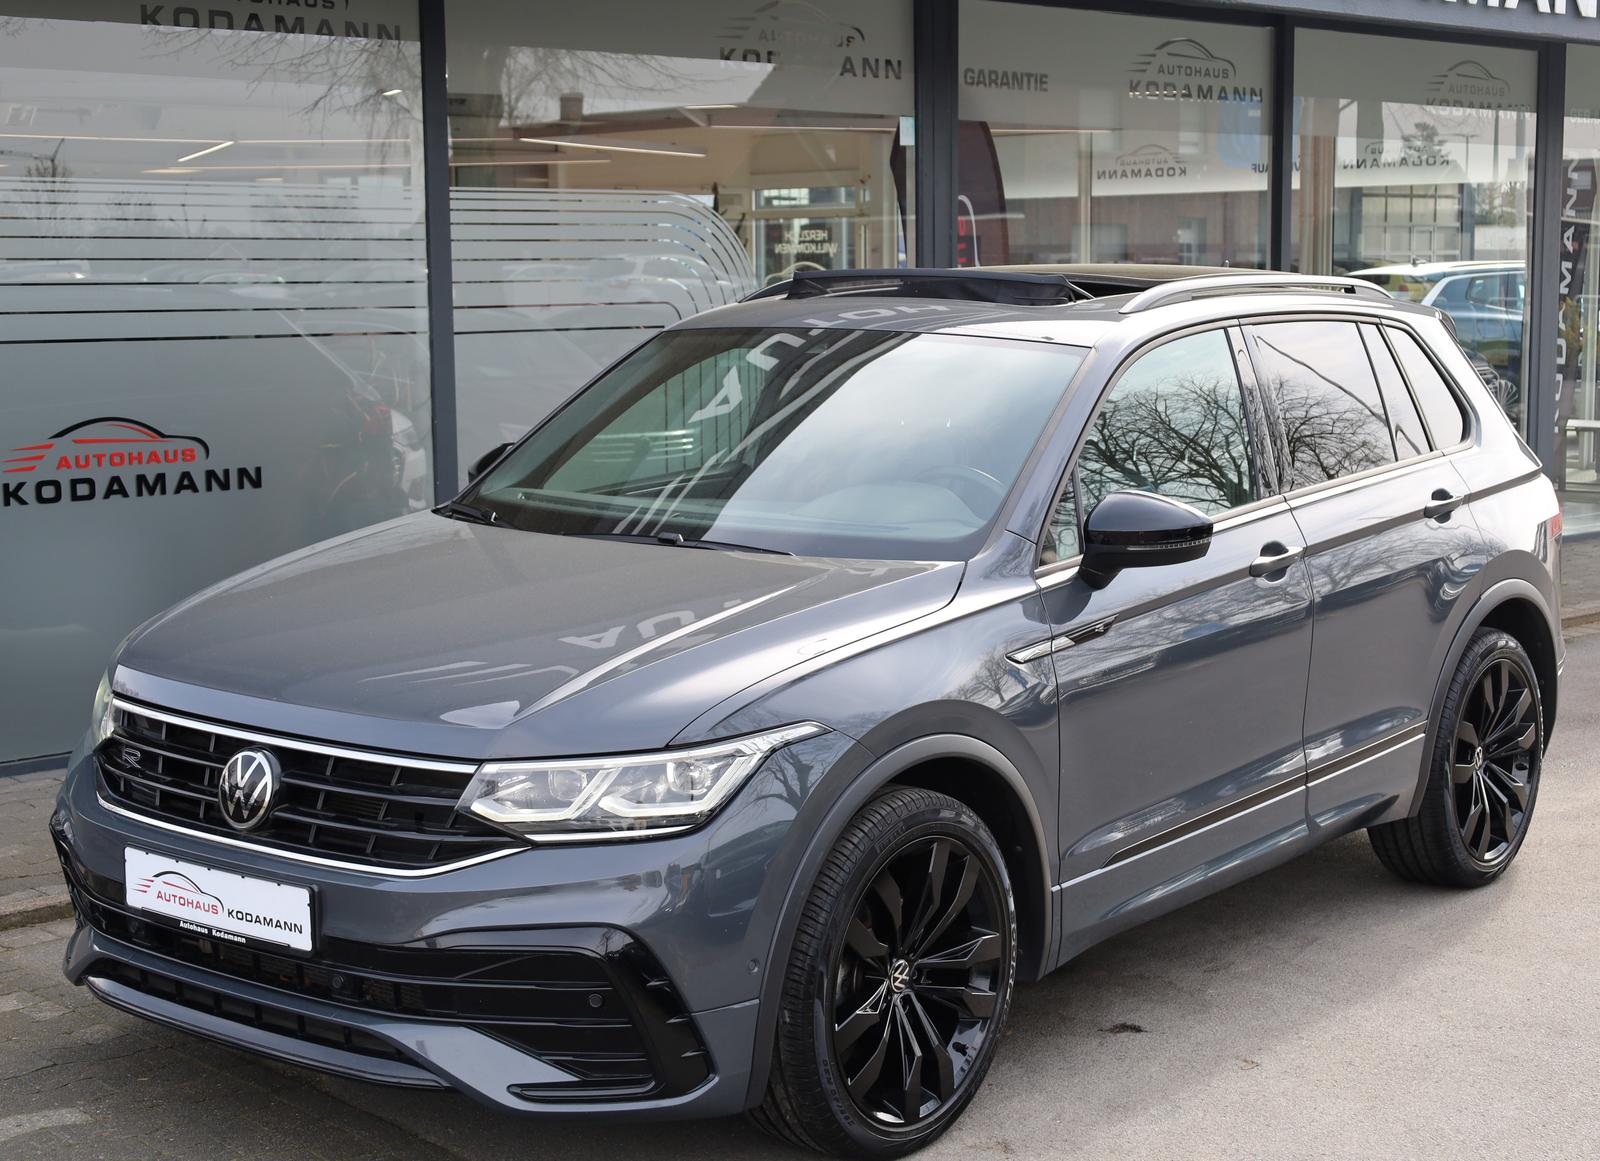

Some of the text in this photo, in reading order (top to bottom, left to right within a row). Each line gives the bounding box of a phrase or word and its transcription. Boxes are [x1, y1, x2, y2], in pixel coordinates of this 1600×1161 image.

[963, 67, 1049, 92] GARANTIE
[1157, 63, 1230, 79] AUTOHAUS
[1129, 79, 1264, 103] KODAMANN
[1448, 84, 1505, 98] AUTOHAUS
[56, 447, 197, 471] AUTOHAUS
[2, 466, 262, 508] KODAMANN
[156, 889, 303, 935] AUTOHAUS KODAMANN
[179, 920, 246, 944] Autohaus Kodamann
